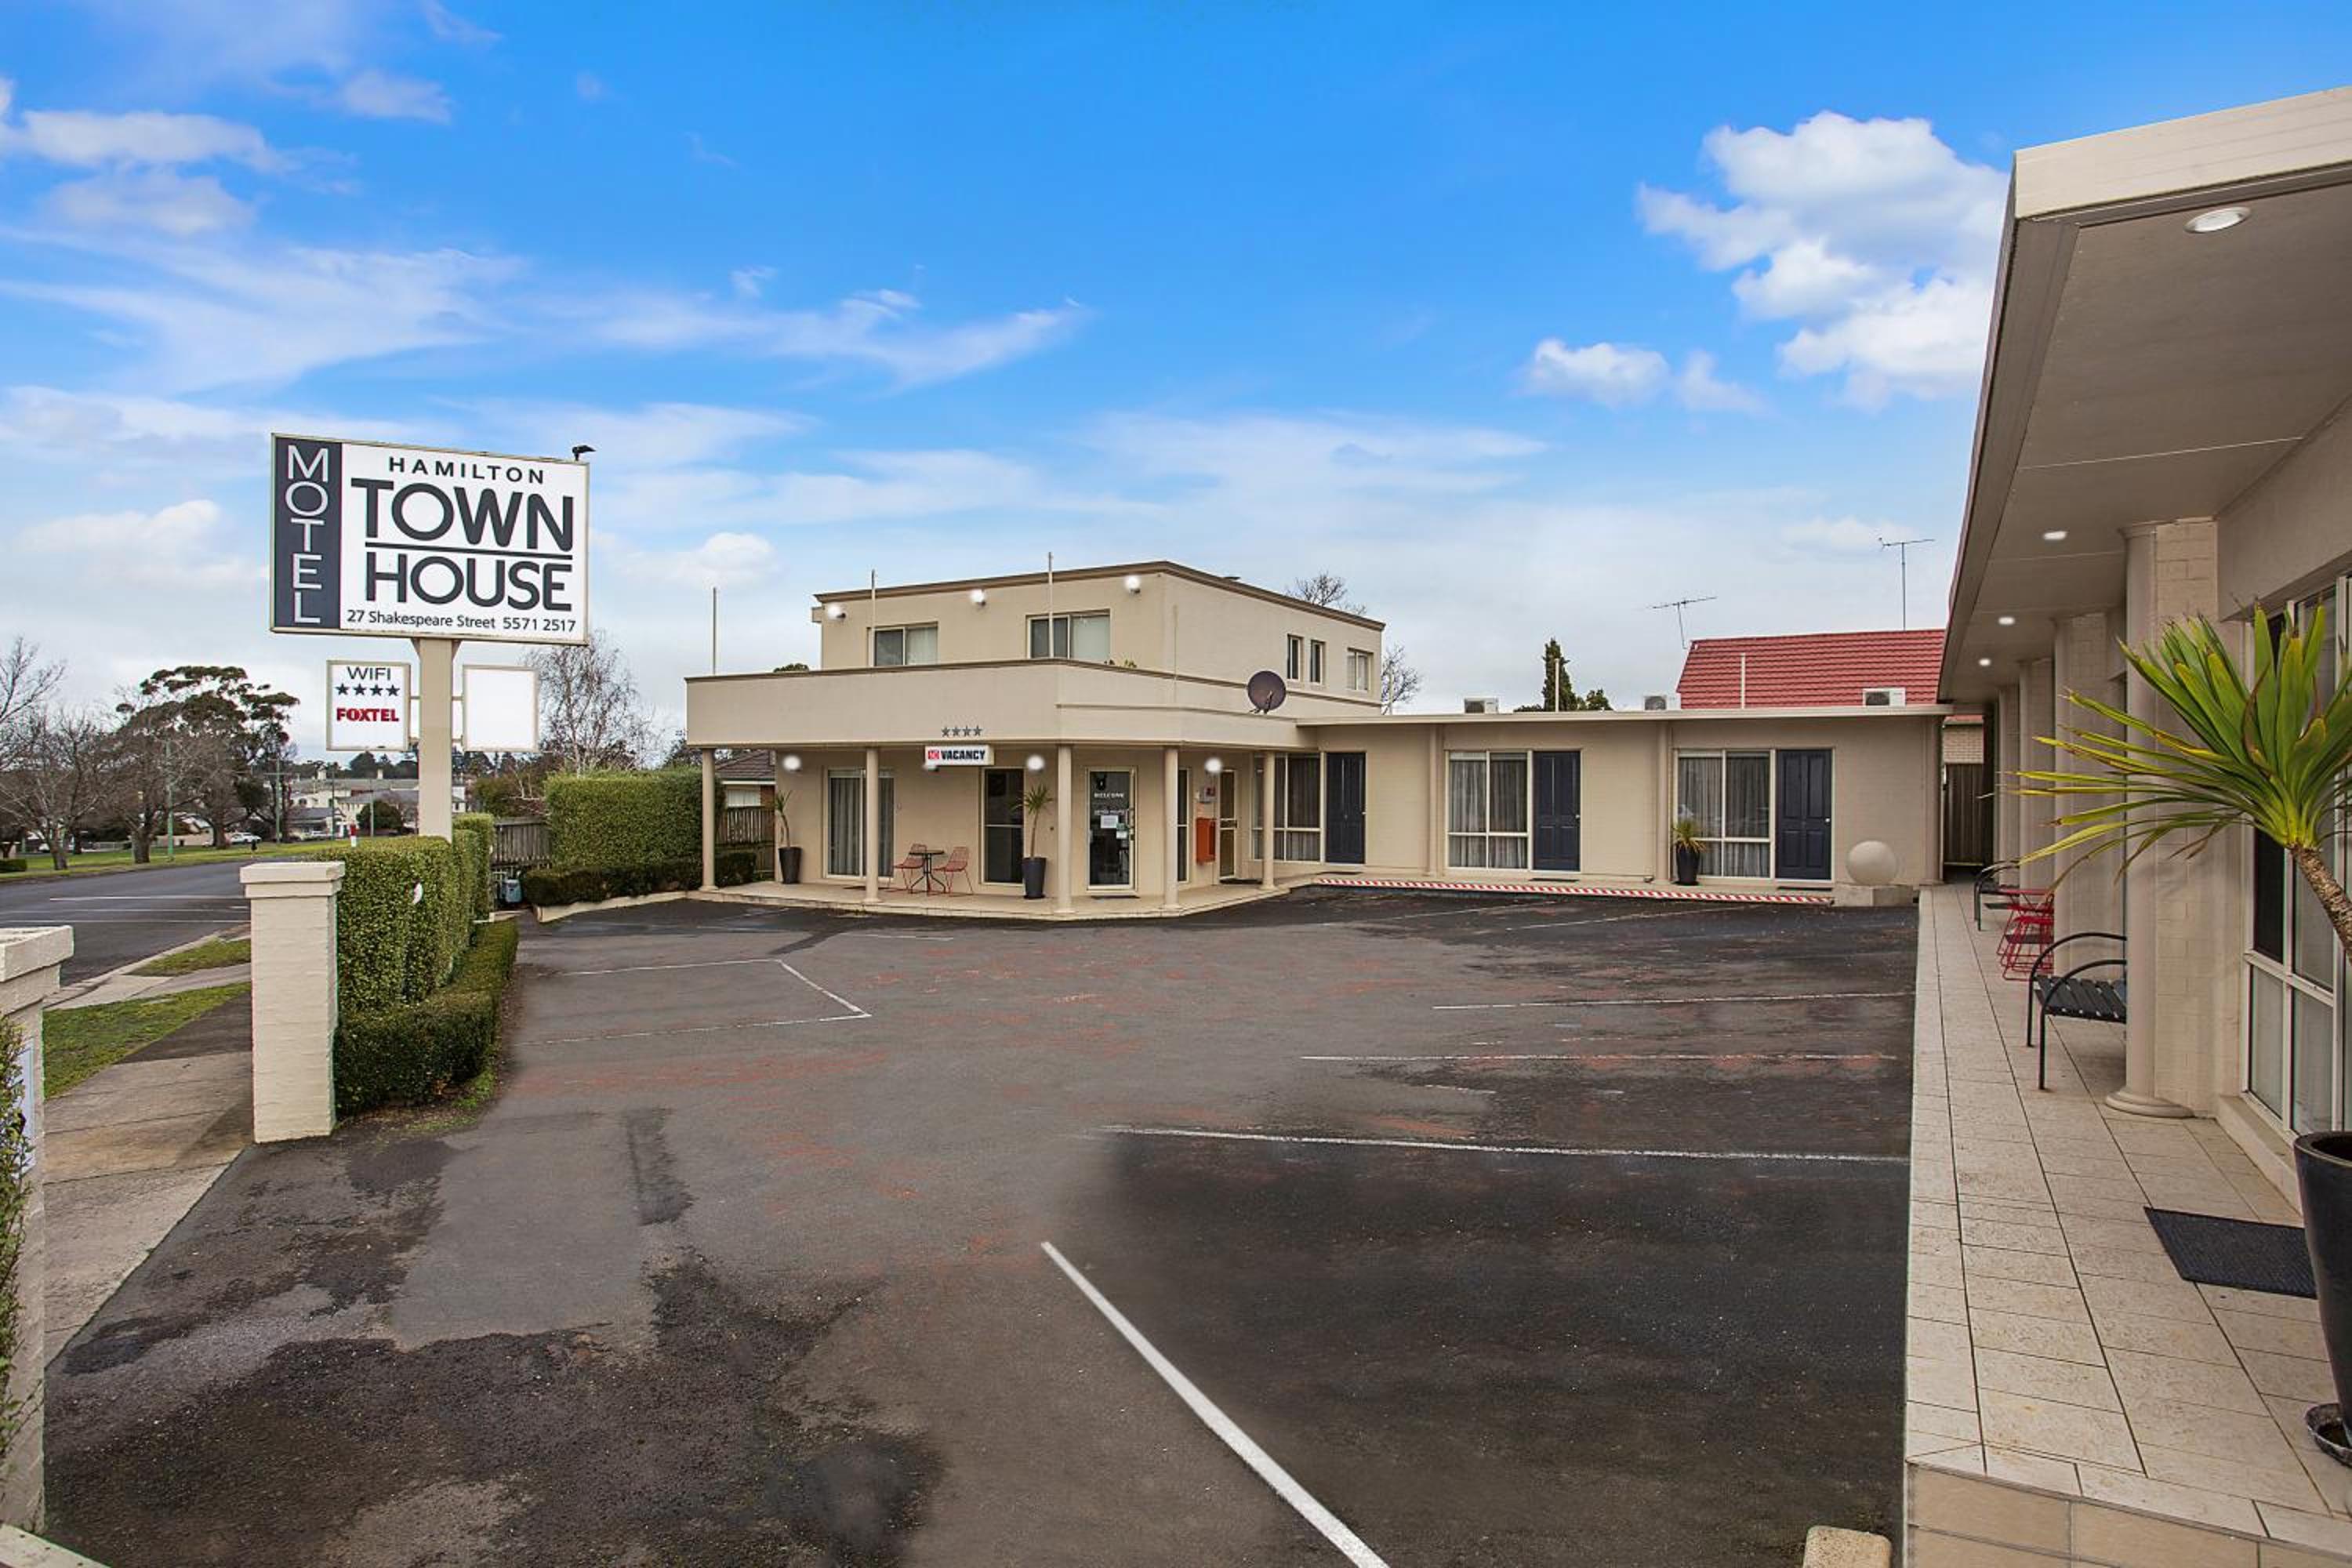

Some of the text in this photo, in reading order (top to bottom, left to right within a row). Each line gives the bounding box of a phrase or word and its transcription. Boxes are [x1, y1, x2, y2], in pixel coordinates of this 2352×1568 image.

[389, 456, 543, 484] HAMILTON
[351, 477, 573, 551] TOWN
[285, 445, 328, 624] MOTEL
[366, 552, 573, 612] HOUSE
[347, 609, 576, 633] 27 Shakespeare Street 5571 2517
[347, 666, 390, 681] WIFI
[336, 708, 399, 721] FOXTEL
[941, 750, 985, 760] VACANCY
